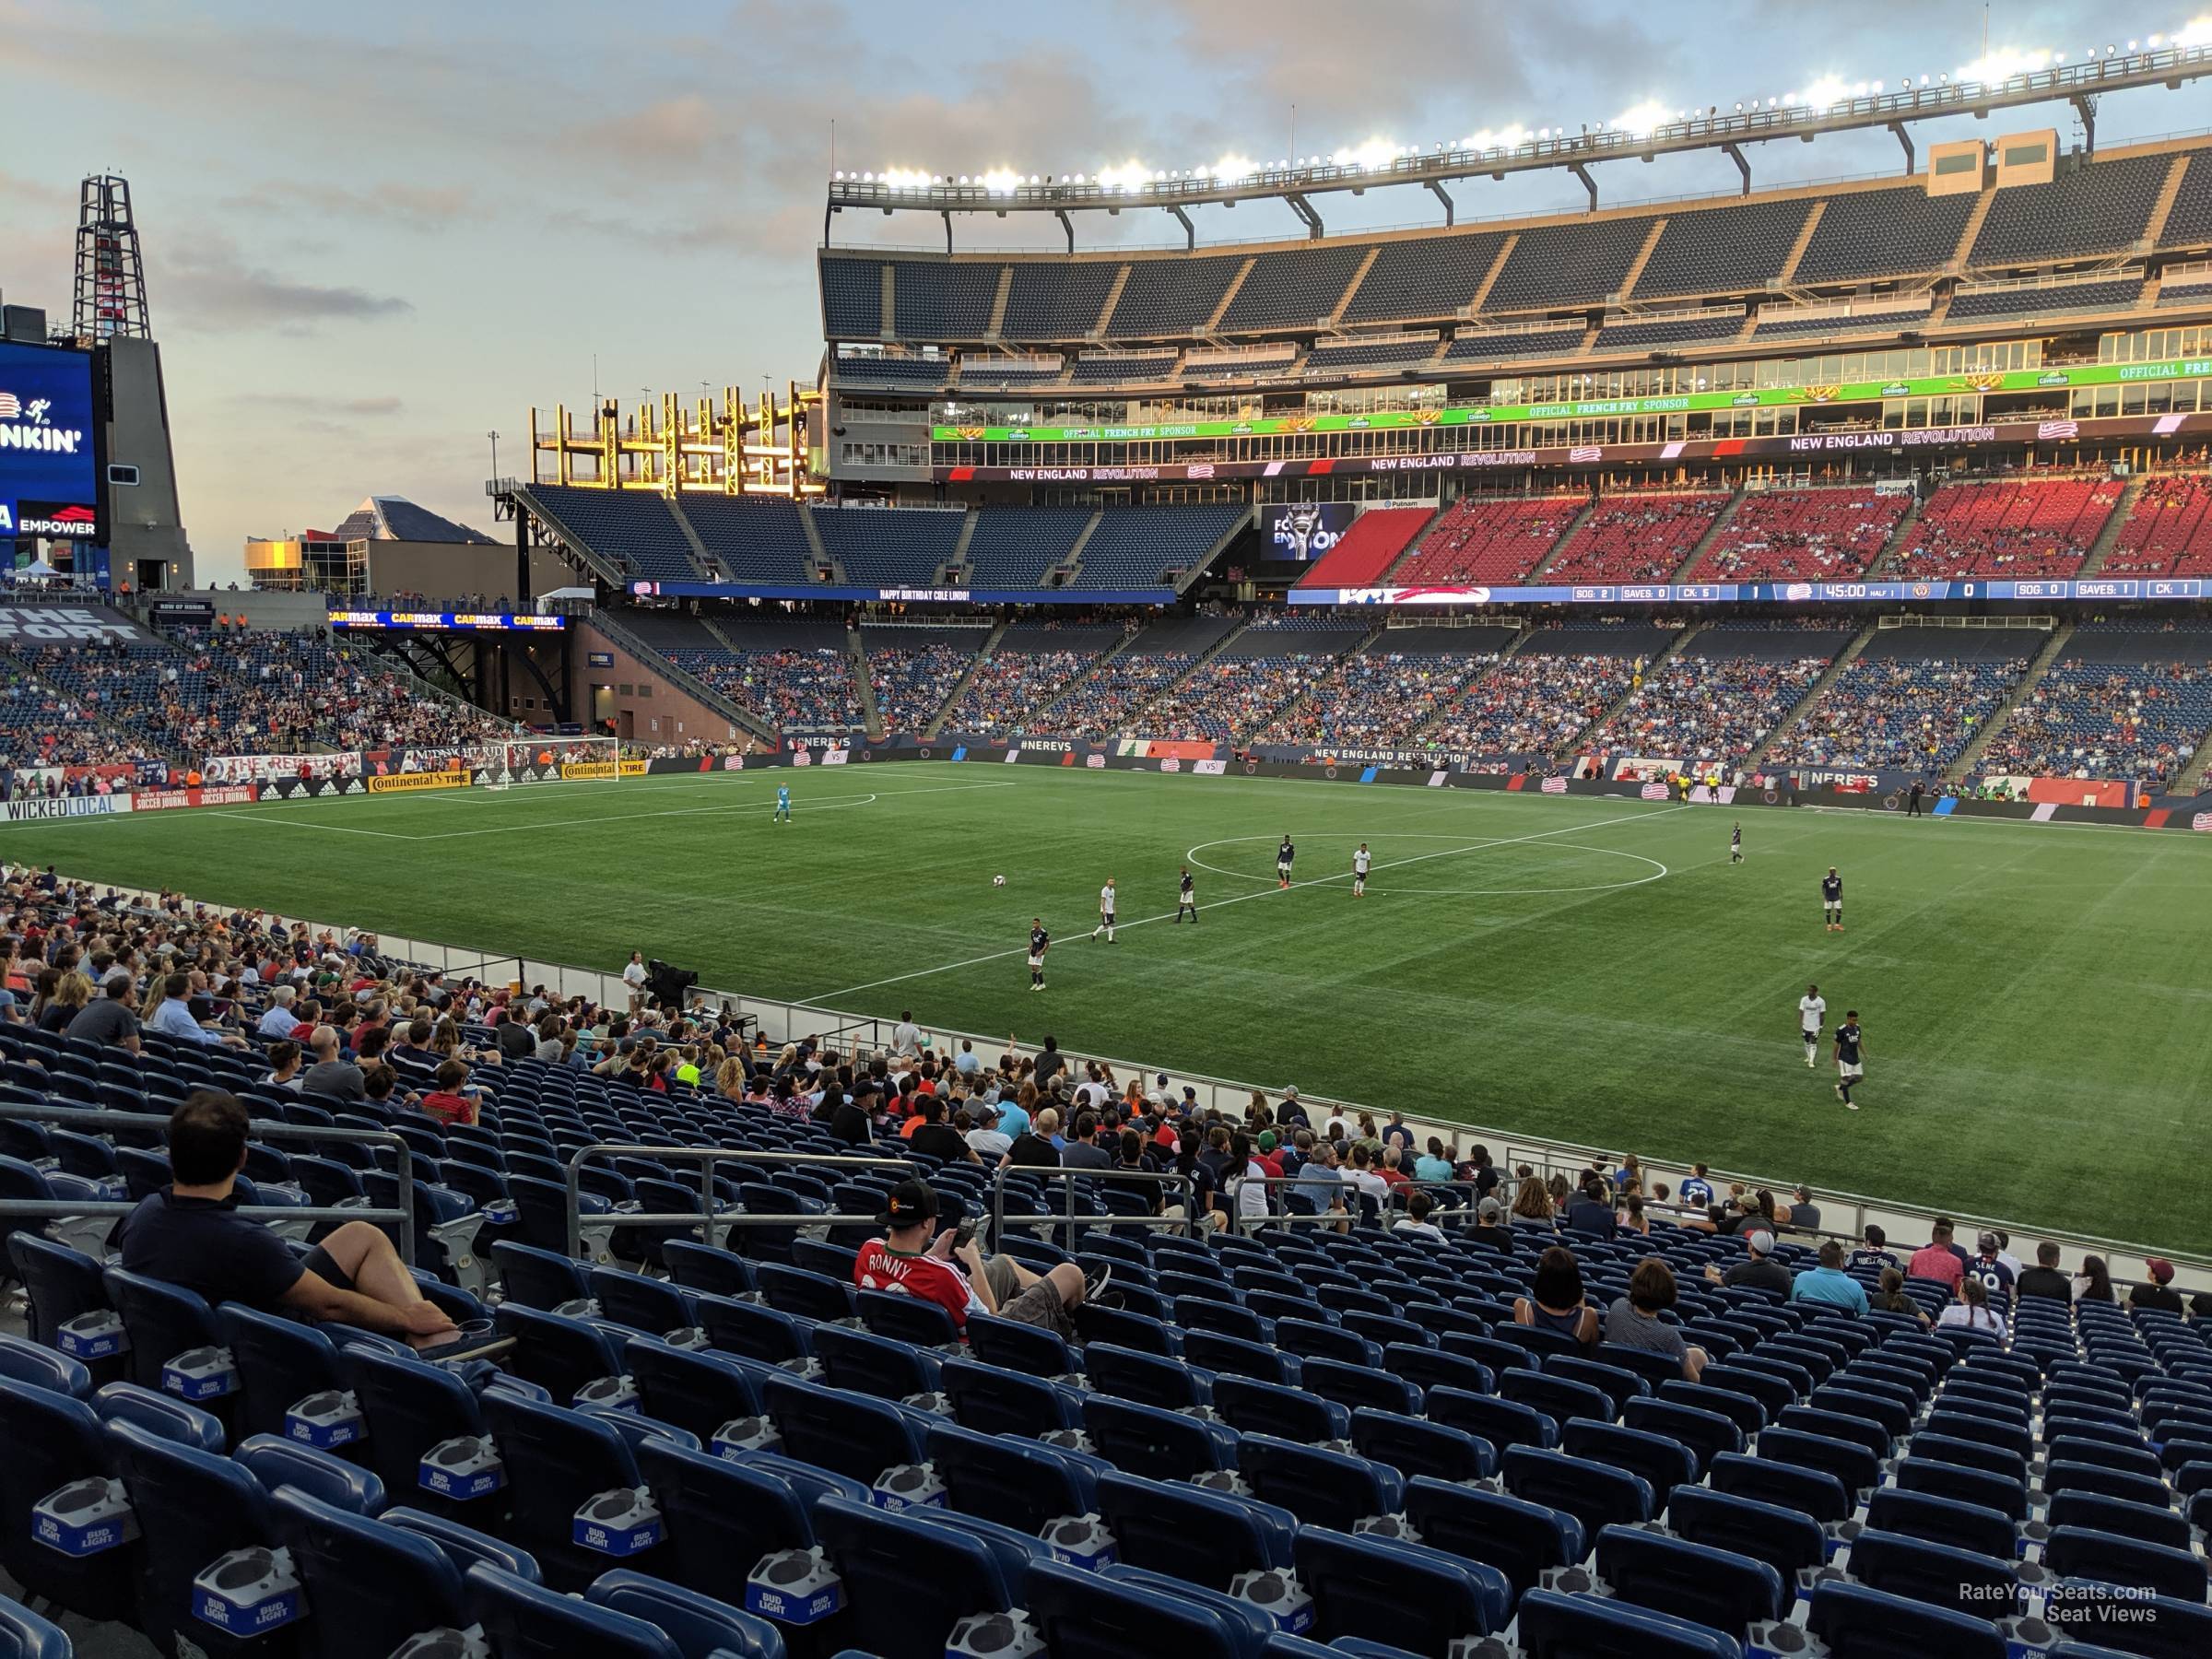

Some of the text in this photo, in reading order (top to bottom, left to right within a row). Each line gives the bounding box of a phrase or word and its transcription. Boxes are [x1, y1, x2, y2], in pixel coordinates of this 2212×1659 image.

[2120, 361, 2212, 379] OFFICIAL FRE
[1530, 398, 1689, 417] OFFICIAL FRENCH FRY SPONSOR
[1064, 426, 1196, 439] OFFICIAL FRENCH FRY SPONSOR
[1791, 428, 1994, 451] NEW ENGLAND REVOLUTION
[1371, 452, 1535, 470] NEW ENGLAND REVOLUTION
[1011, 468, 1159, 480] NEW ENGLAND REVOLUTION
[19, 520, 96, 535] EMPOWER
[880, 589, 900, 600] HAPPY
[901, 590, 933, 601] BIRTHDAY
[934, 591, 948, 601] COLE
[1576, 589, 1607, 598] SOG: 2
[1624, 588, 1665, 598] SAVES: 0
[1683, 588, 1710, 597] CK: 5
[1753, 586, 1759, 598] 1
[1826, 585, 1865, 597] 45:00
[1964, 583, 1974, 596] 0
[2019, 584, 2058, 595] SOG: 0
[2079, 583, 2128, 595] SAVES: 1
[2156, 583, 2189, 594] CK: 1
[0, 608, 105, 624] THE
[1021, 739, 1072, 752] #NEREVS
[1314, 748, 1339, 758] NEW
[1342, 749, 1394, 760] ENGLAND
[564, 762, 643, 778] Continental TIRE
[1206, 762, 1216, 771] VS
[371, 773, 468, 791] Continental TIRE
[201, 791, 252, 805] SOCCER JOURNAL
[260, 793, 283, 801] adidas
[288, 791, 311, 799] adidas
[7, 795, 116, 819] WICKEDLOCAL
[137, 795, 190, 809] SOCCER JOURNAL
[869, 1254, 912, 1280] RONNY
[432, 1471, 449, 1483] BUD
[429, 1477, 452, 1491] LIGHT
[884, 1502, 905, 1513] LIGH
[887, 1496, 903, 1507] BUD
[42, 1518, 58, 1533] BUD
[39, 1525, 62, 1543] LIGHT
[88, 1528, 110, 1539] BUD
[588, 1526, 606, 1539] BUD
[633, 1531, 651, 1542] BUD
[81, 1534, 114, 1548] LIGHT
[585, 1535, 609, 1548] LIGHT
[630, 1536, 653, 1548] LIGHT
[207, 1597, 226, 1611] BUD
[762, 1593, 782, 1606] BUD
[812, 1595, 829, 1608] BUD
[260, 1602, 285, 1615] BUD
[759, 1600, 785, 1615] LIGHT
[809, 1601, 832, 1615] LIGHT
[205, 1606, 229, 1623] LIGHT
[256, 1607, 288, 1625] LIGHT
